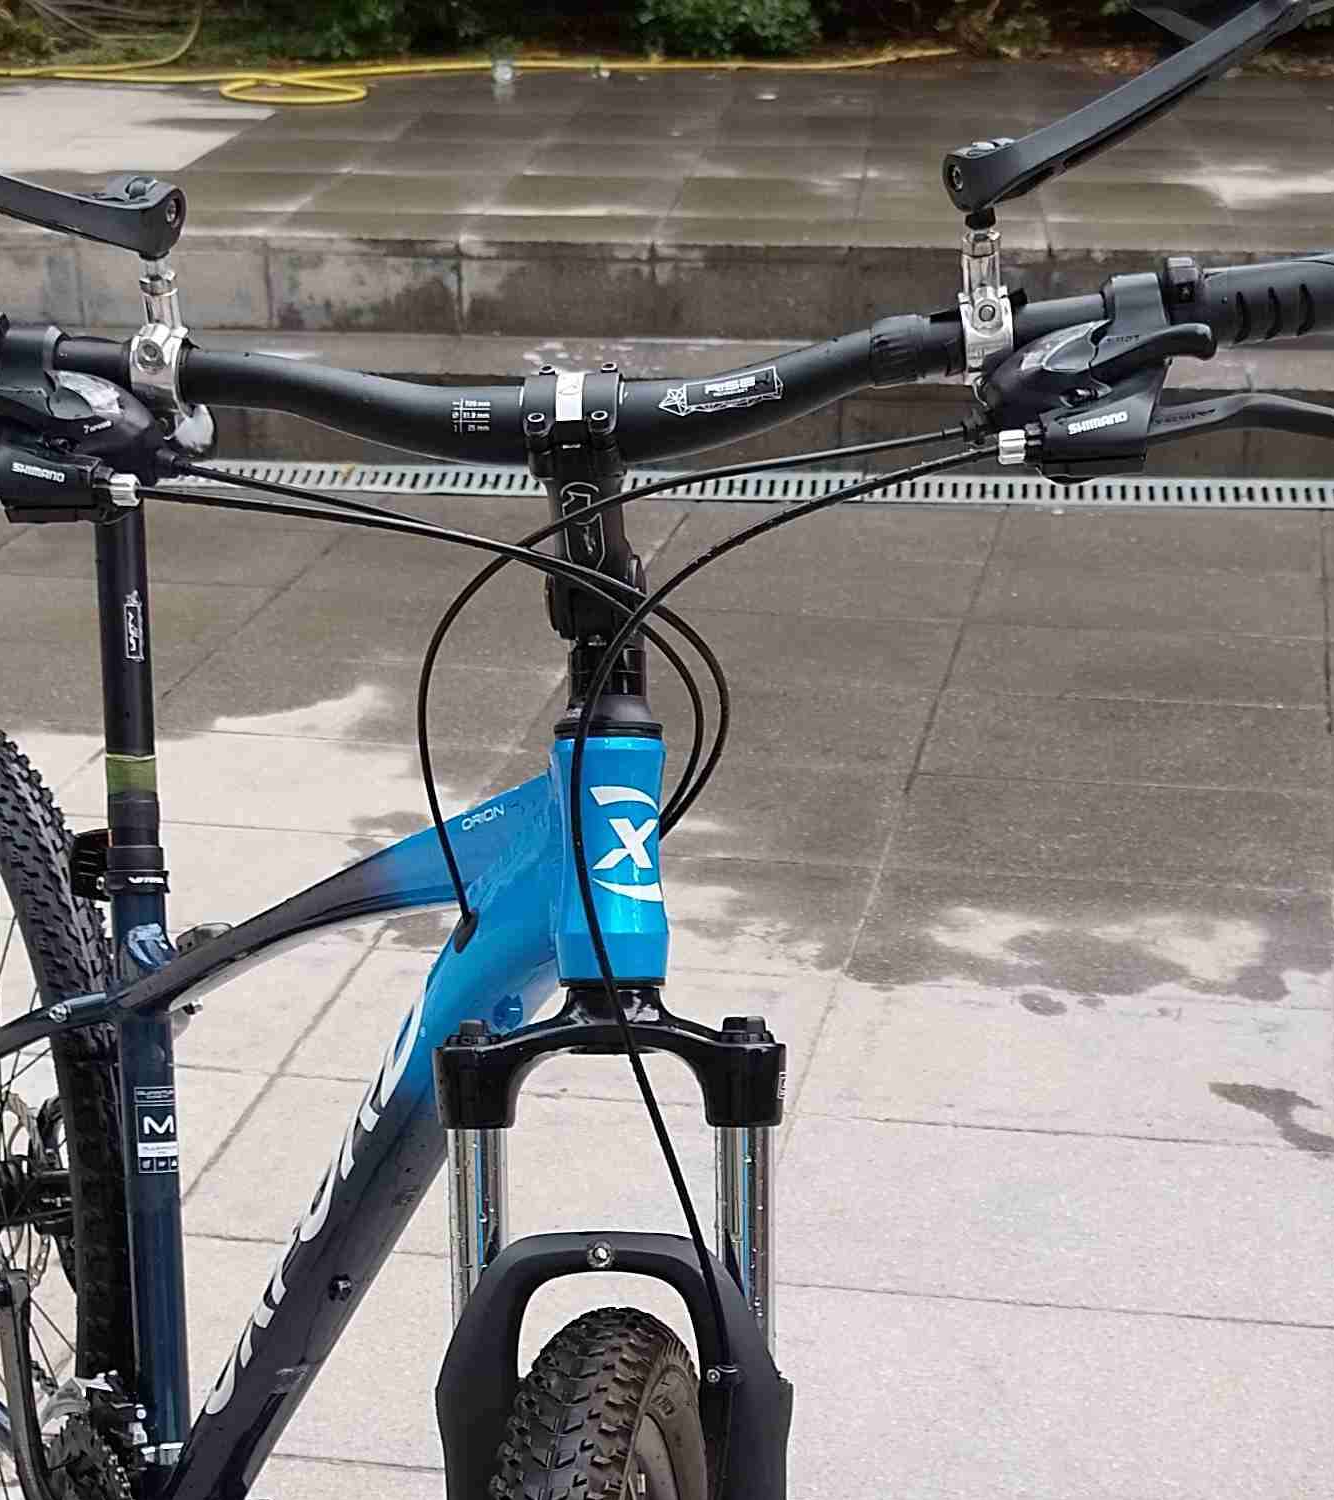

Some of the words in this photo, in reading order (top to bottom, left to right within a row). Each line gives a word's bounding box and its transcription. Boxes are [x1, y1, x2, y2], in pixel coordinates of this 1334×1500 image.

[1067, 411, 1128, 436] SHIMANO
[11, 461, 66, 483] SHIMANO
[461, 803, 506, 831] ORION
[143, 1114, 175, 1135] M
